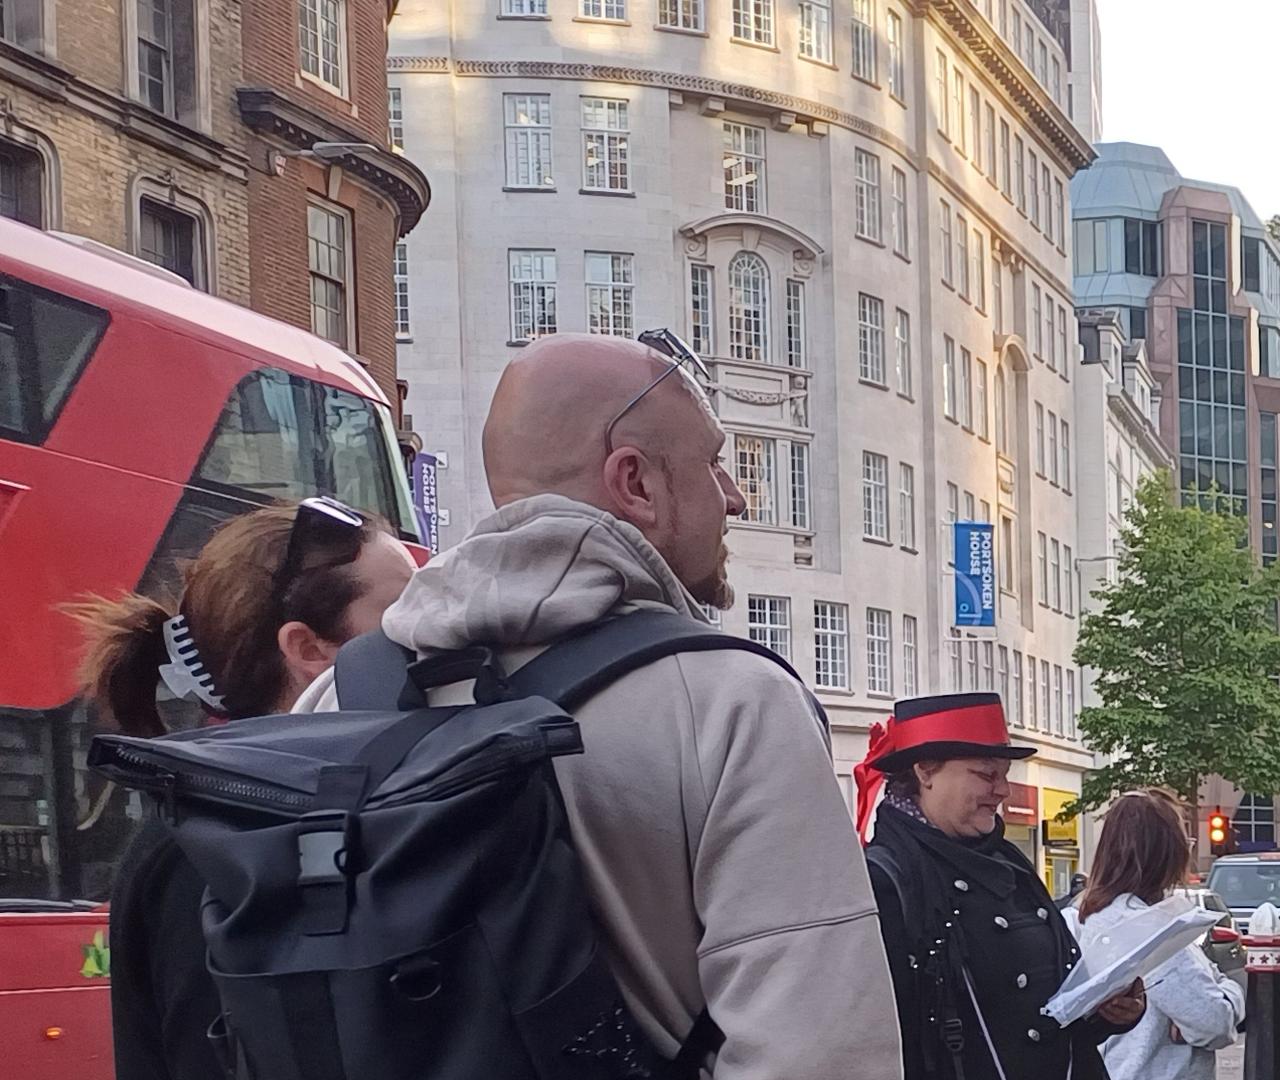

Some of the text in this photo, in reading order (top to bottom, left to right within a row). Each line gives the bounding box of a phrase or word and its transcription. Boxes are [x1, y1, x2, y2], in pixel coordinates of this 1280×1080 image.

[428, 464, 438, 555] PORTSOKEN
[970, 531, 980, 576] HOUSE
[981, 531, 993, 610] PORTSOKEN
